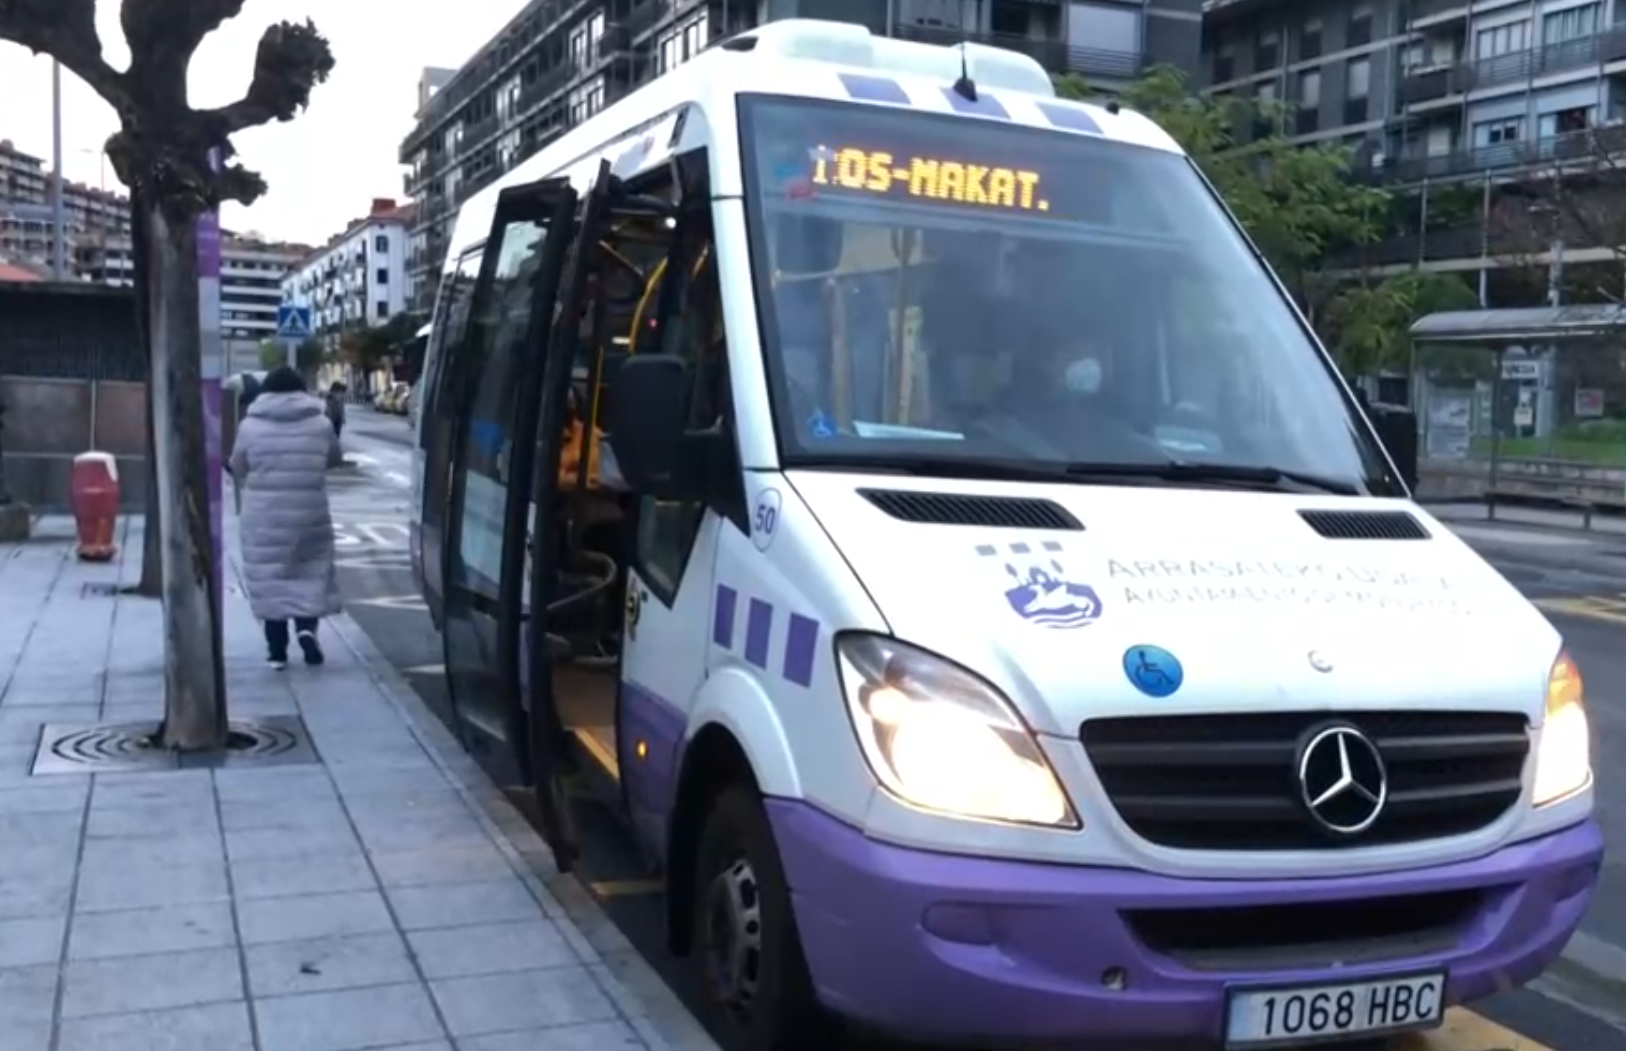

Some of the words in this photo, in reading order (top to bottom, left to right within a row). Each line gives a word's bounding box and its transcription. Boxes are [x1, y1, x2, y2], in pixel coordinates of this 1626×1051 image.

[755, 504, 776, 535] 50
[1264, 990, 1355, 1036] 1068
[1367, 982, 1436, 1026] HBC
